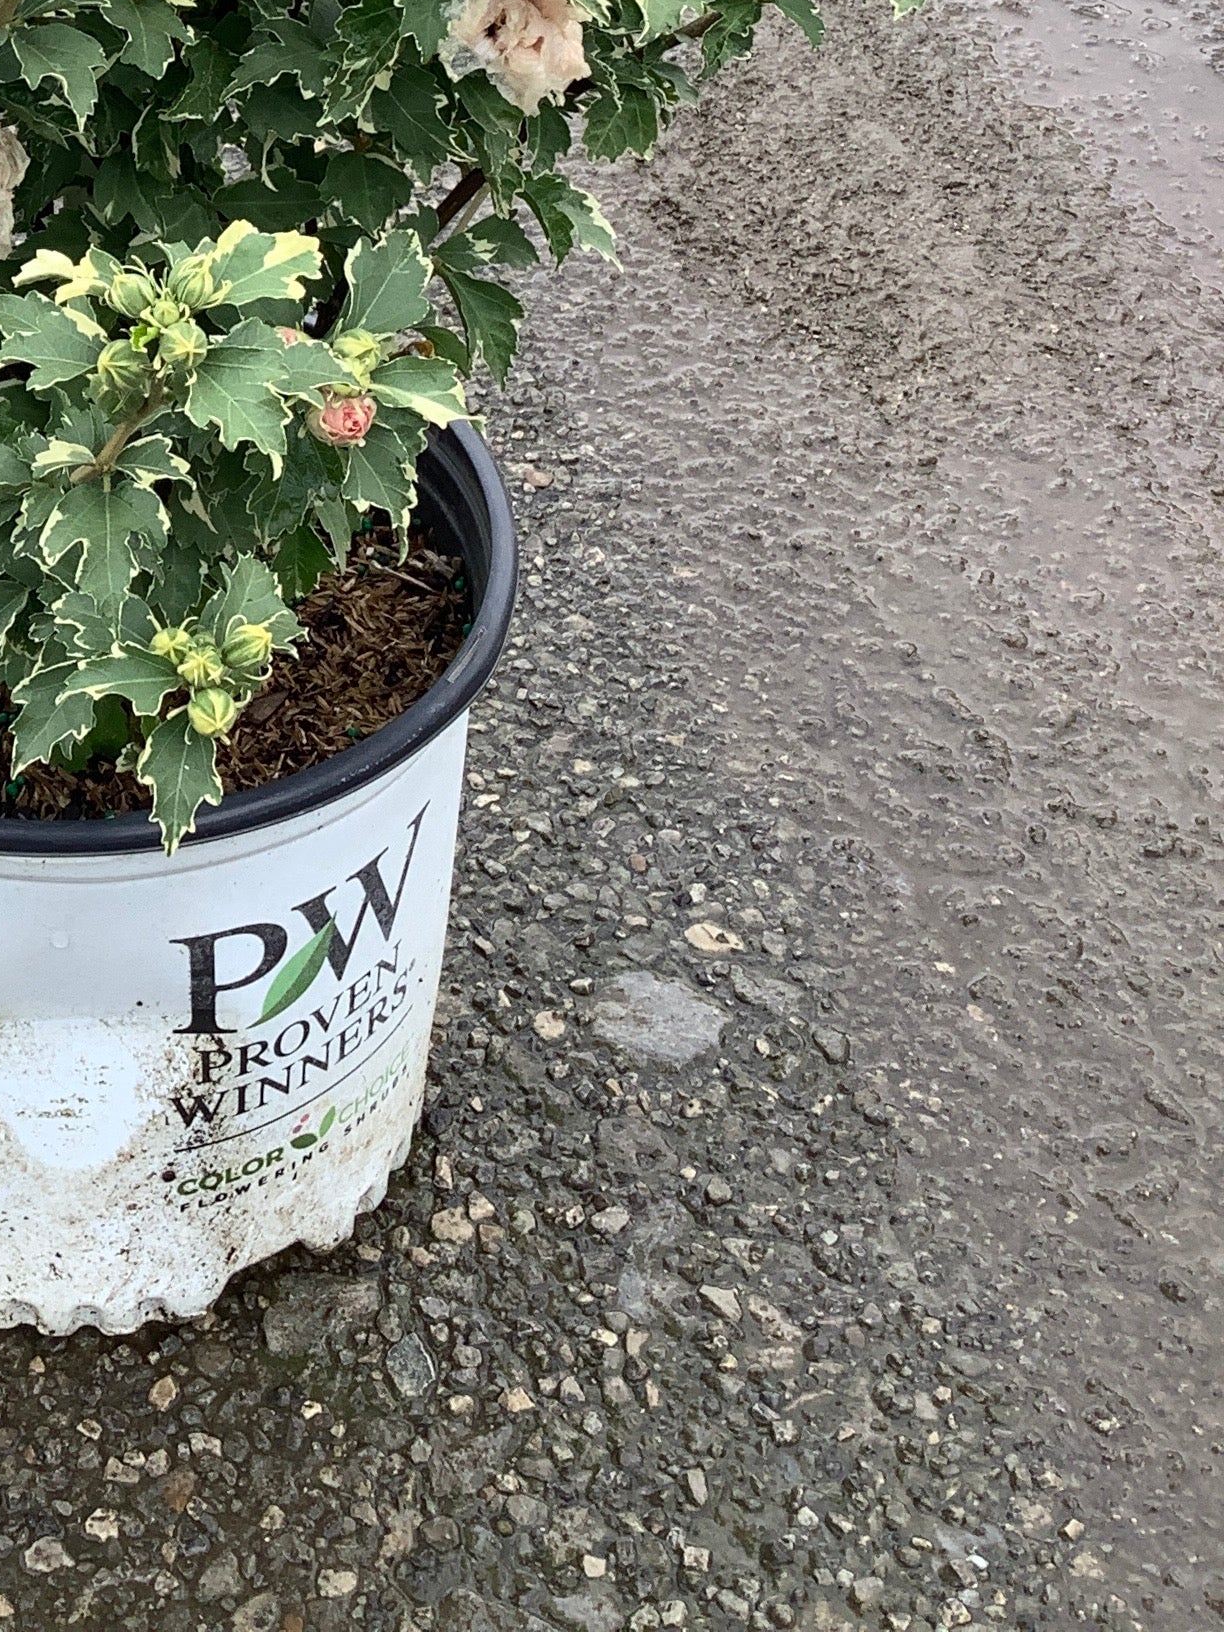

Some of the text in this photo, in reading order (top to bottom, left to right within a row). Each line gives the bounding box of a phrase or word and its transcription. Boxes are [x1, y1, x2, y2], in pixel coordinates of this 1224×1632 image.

[169, 799, 431, 1034] PW
[197, 939, 402, 1084] PROVEN
[177, 1043, 410, 1196] COLOR CHOICE
[180, 1141, 329, 1212] FLOWERING
